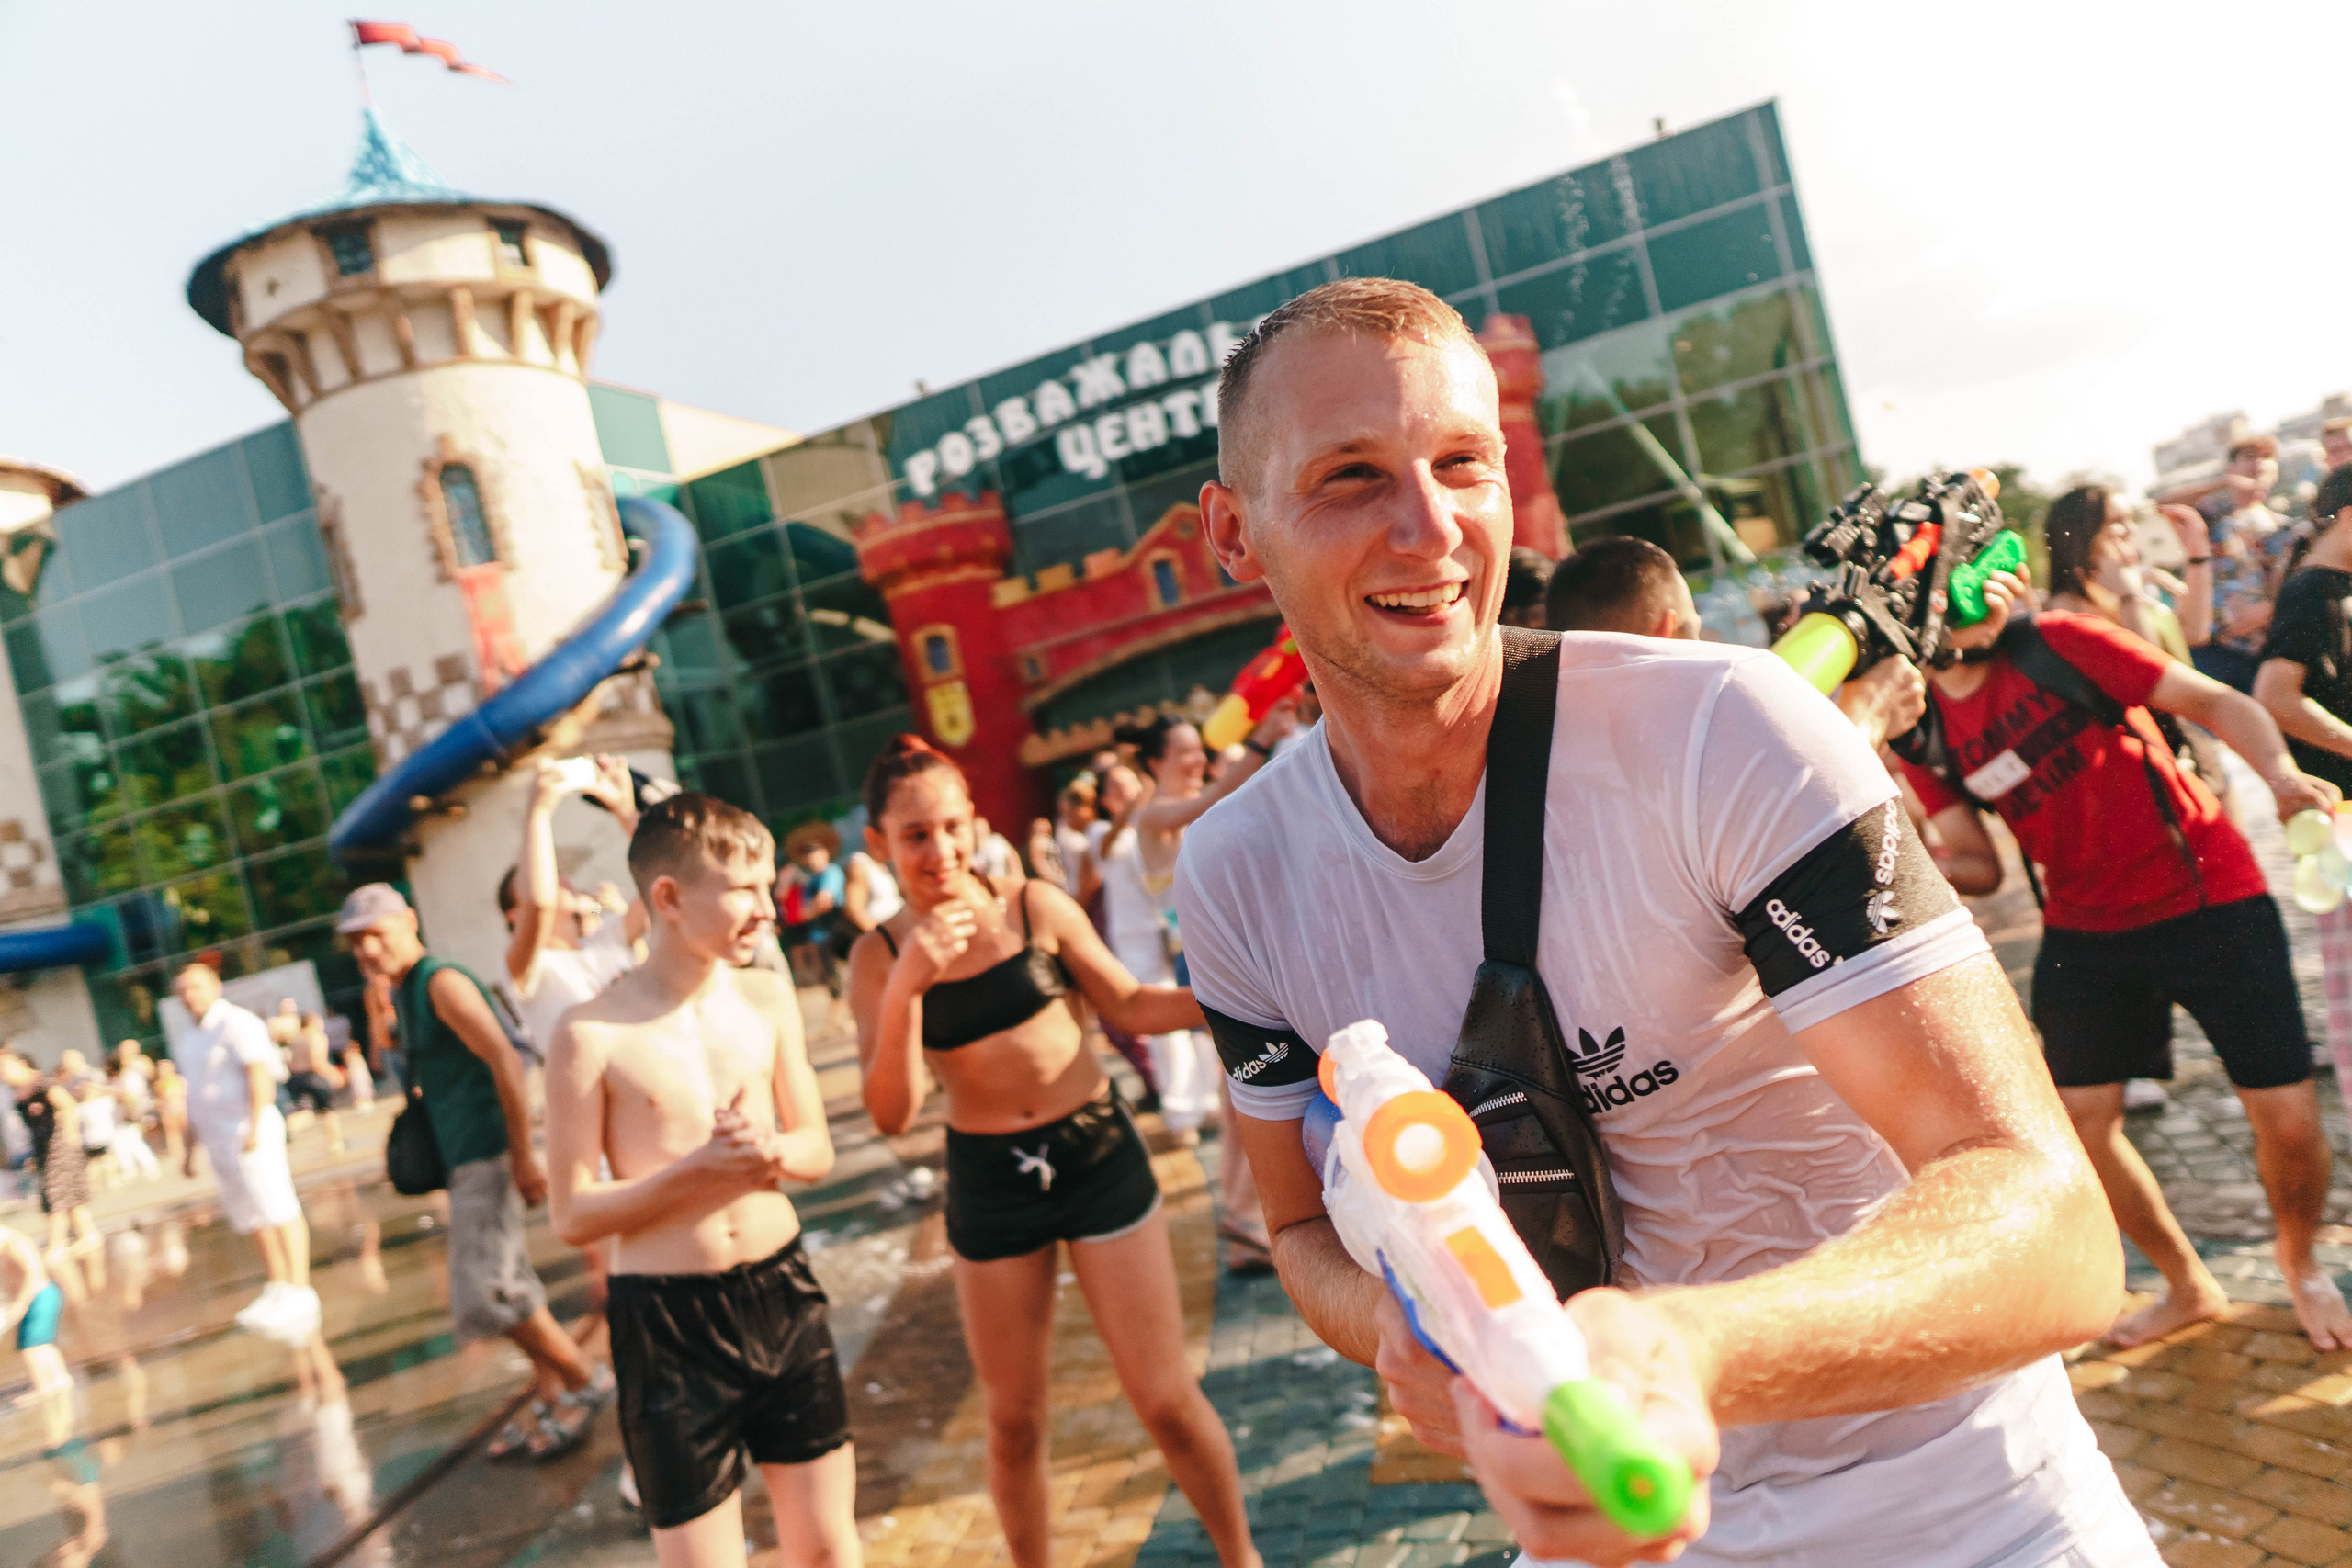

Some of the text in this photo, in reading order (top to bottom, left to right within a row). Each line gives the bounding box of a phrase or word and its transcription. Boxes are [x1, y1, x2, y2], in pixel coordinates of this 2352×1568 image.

[904, 315, 1266, 496] РОЗВАЖАЛЬ
[1875, 798, 1901, 886] adidas
[1765, 898, 1832, 968] adidas
[1233, 1059, 1267, 1082] didas
[1581, 1060, 1679, 1114] didas
